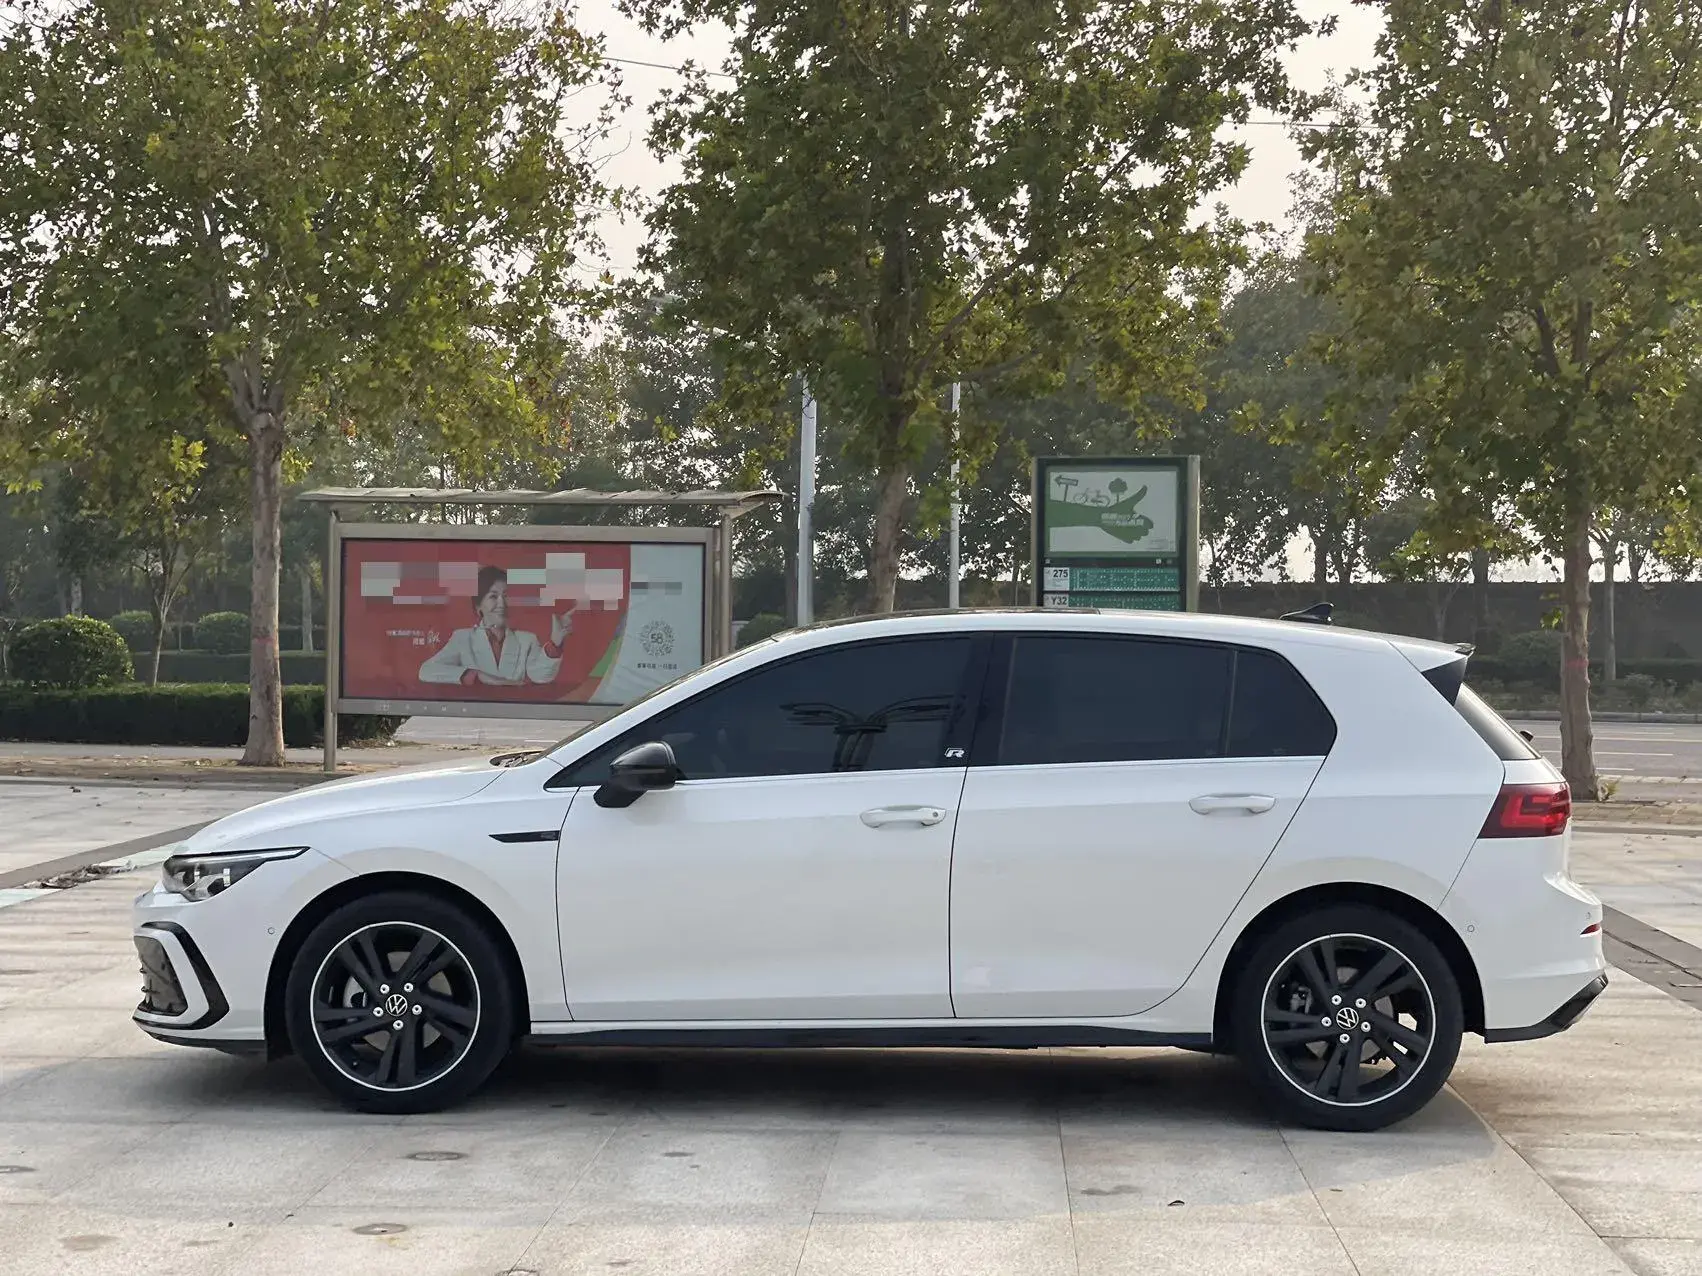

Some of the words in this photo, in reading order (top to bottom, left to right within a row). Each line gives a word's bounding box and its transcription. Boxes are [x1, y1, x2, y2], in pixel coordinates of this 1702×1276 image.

[1053, 569, 1068, 578] 275
[1051, 596, 1067, 605] Y32
[651, 633, 663, 645] 58
[945, 748, 965, 758] R
[386, 994, 408, 1016] VW
[1336, 1007, 1359, 1030] VW
